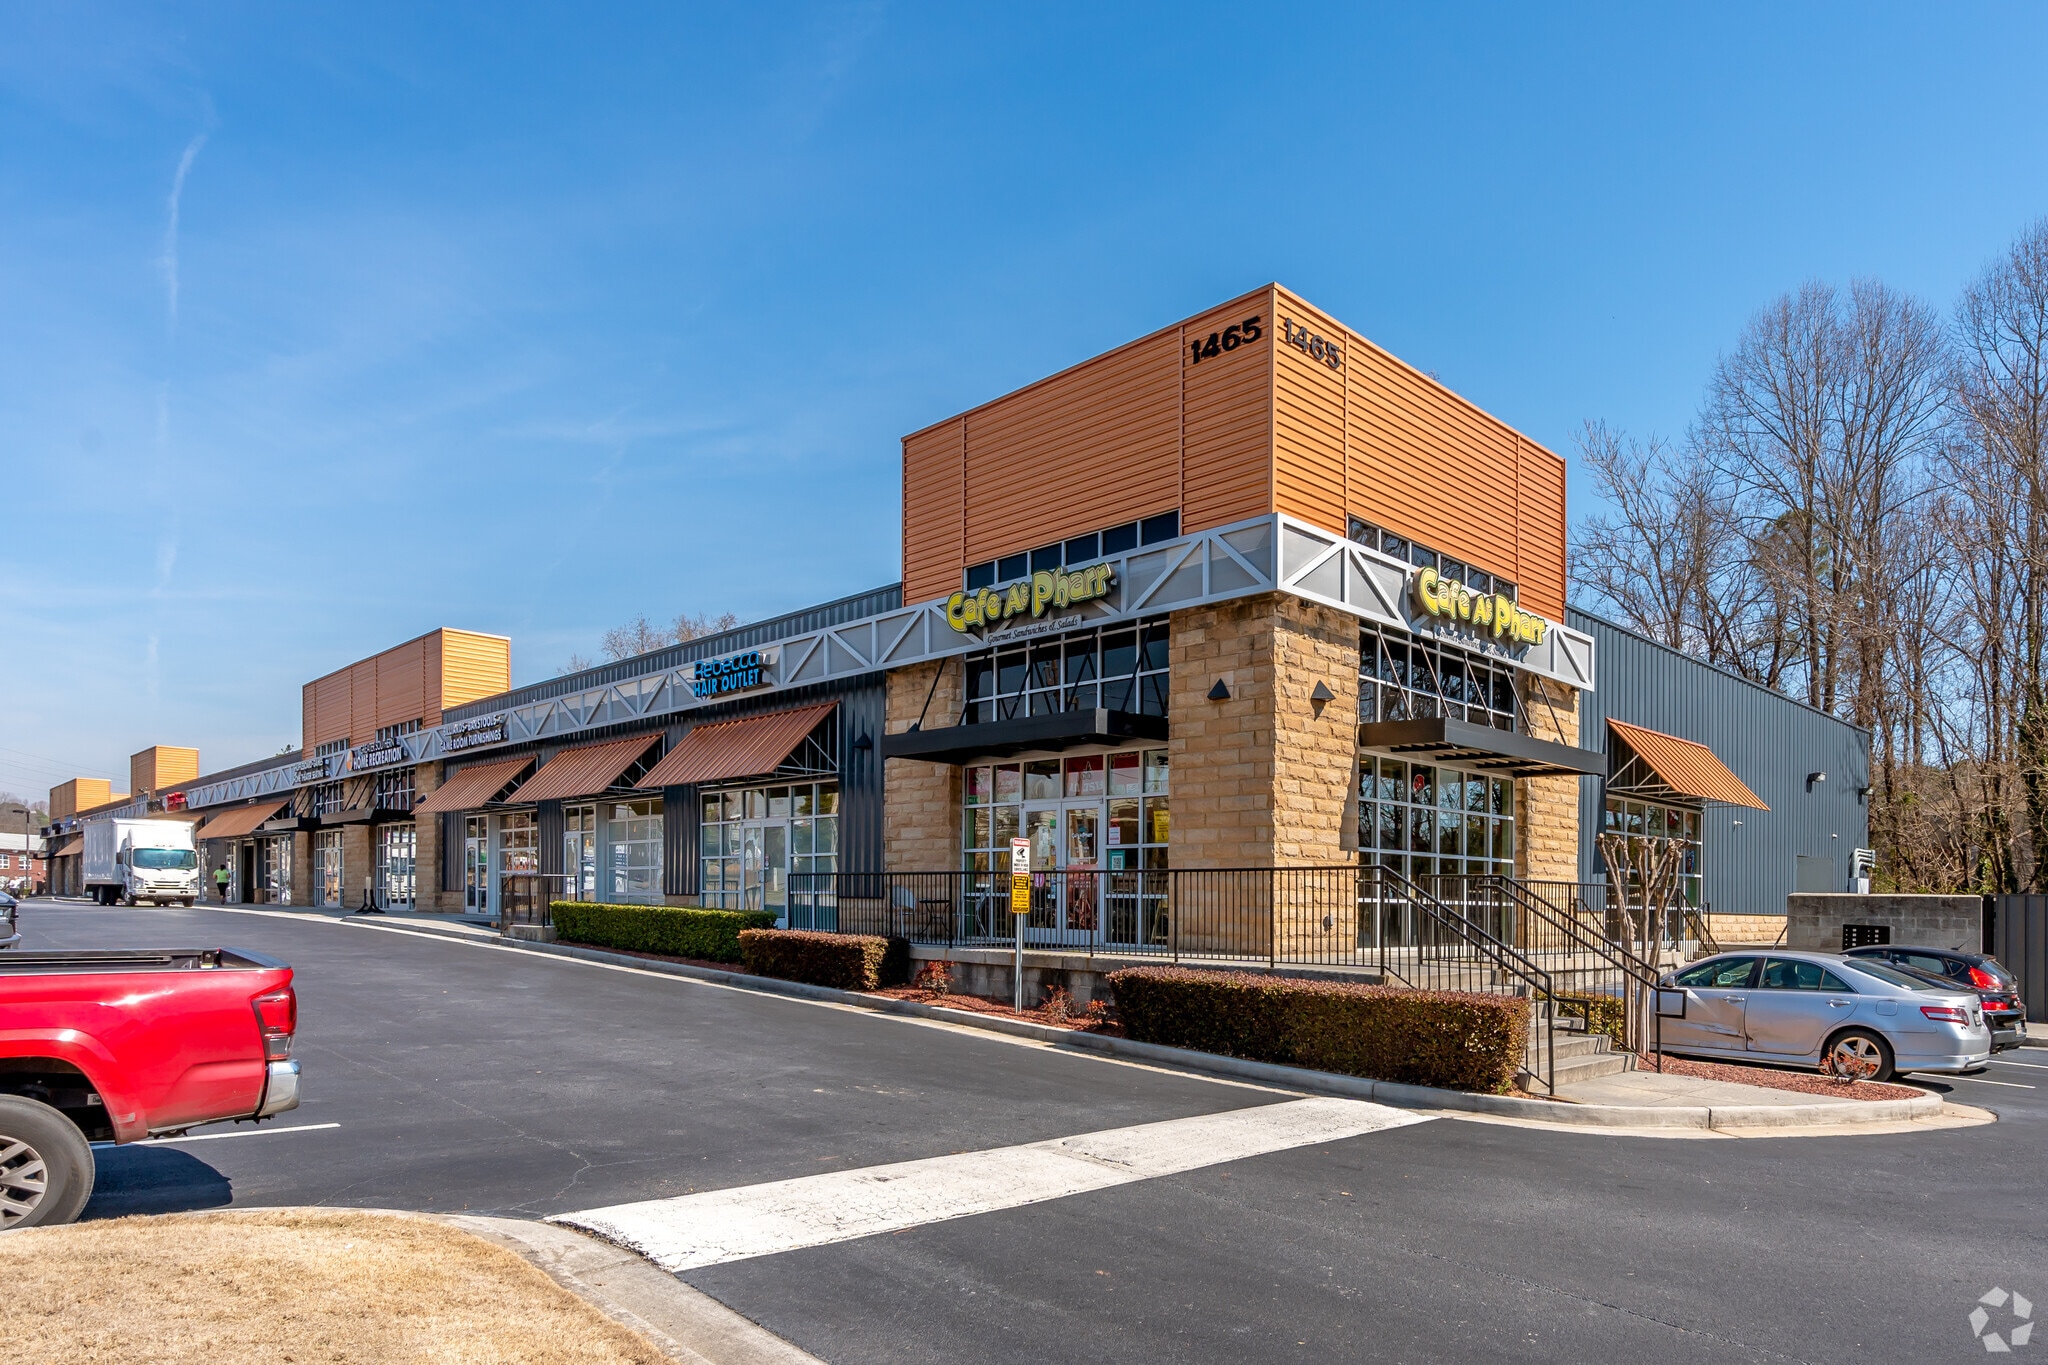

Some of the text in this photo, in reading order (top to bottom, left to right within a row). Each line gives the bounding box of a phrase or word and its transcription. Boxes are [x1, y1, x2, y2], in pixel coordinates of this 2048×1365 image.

[1191, 315, 1262, 364] 1465
[1284, 317, 1341, 369] 1465
[946, 562, 1112, 633] Cafe At Pharr
[1418, 566, 1471, 620] Cafe
[1472, 593, 1494, 625] At
[1493, 593, 1547, 646] Pharr
[987, 632, 1012, 646] Gourmet
[1013, 624, 1048, 640] Sandwiches
[1057, 616, 1078, 631] Salads
[693, 650, 759, 680] Rebecca
[693, 668, 759, 698] HAIR OUTLET
[353, 747, 402, 770] HOME RECREATION
